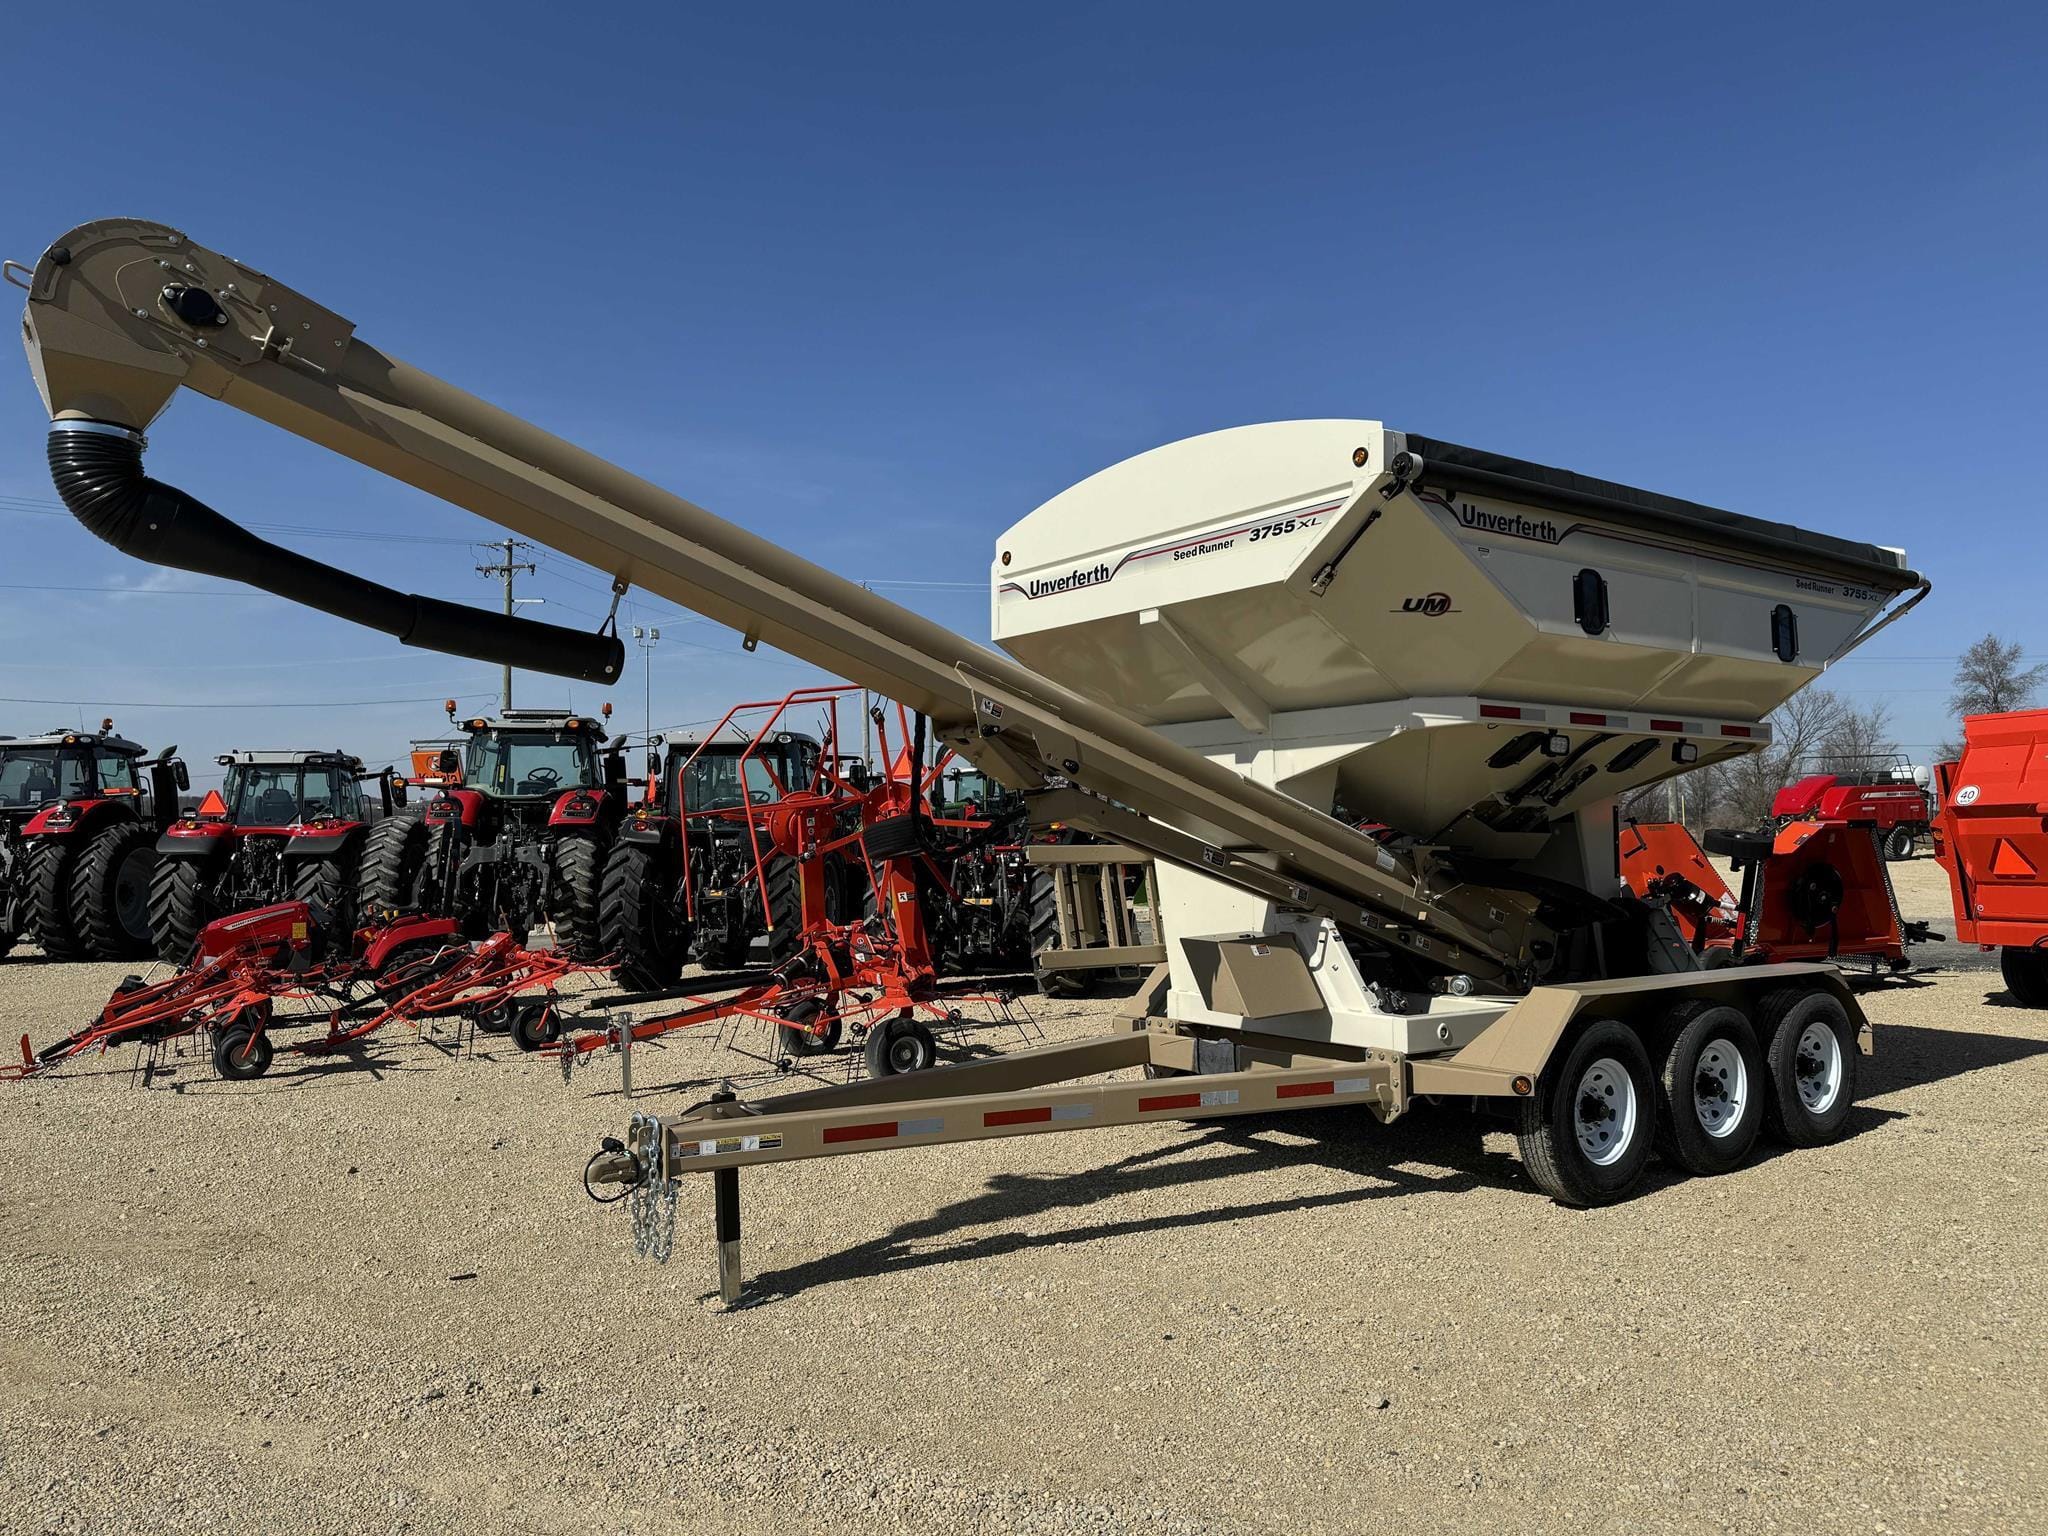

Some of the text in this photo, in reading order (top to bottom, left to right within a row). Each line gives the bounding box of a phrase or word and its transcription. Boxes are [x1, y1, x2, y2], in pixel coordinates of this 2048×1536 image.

[1462, 504, 1557, 541] Unverferth
[1030, 564, 1109, 597] Unverferth
[1402, 596, 1449, 613] UM
[1960, 790, 1975, 799] 40
